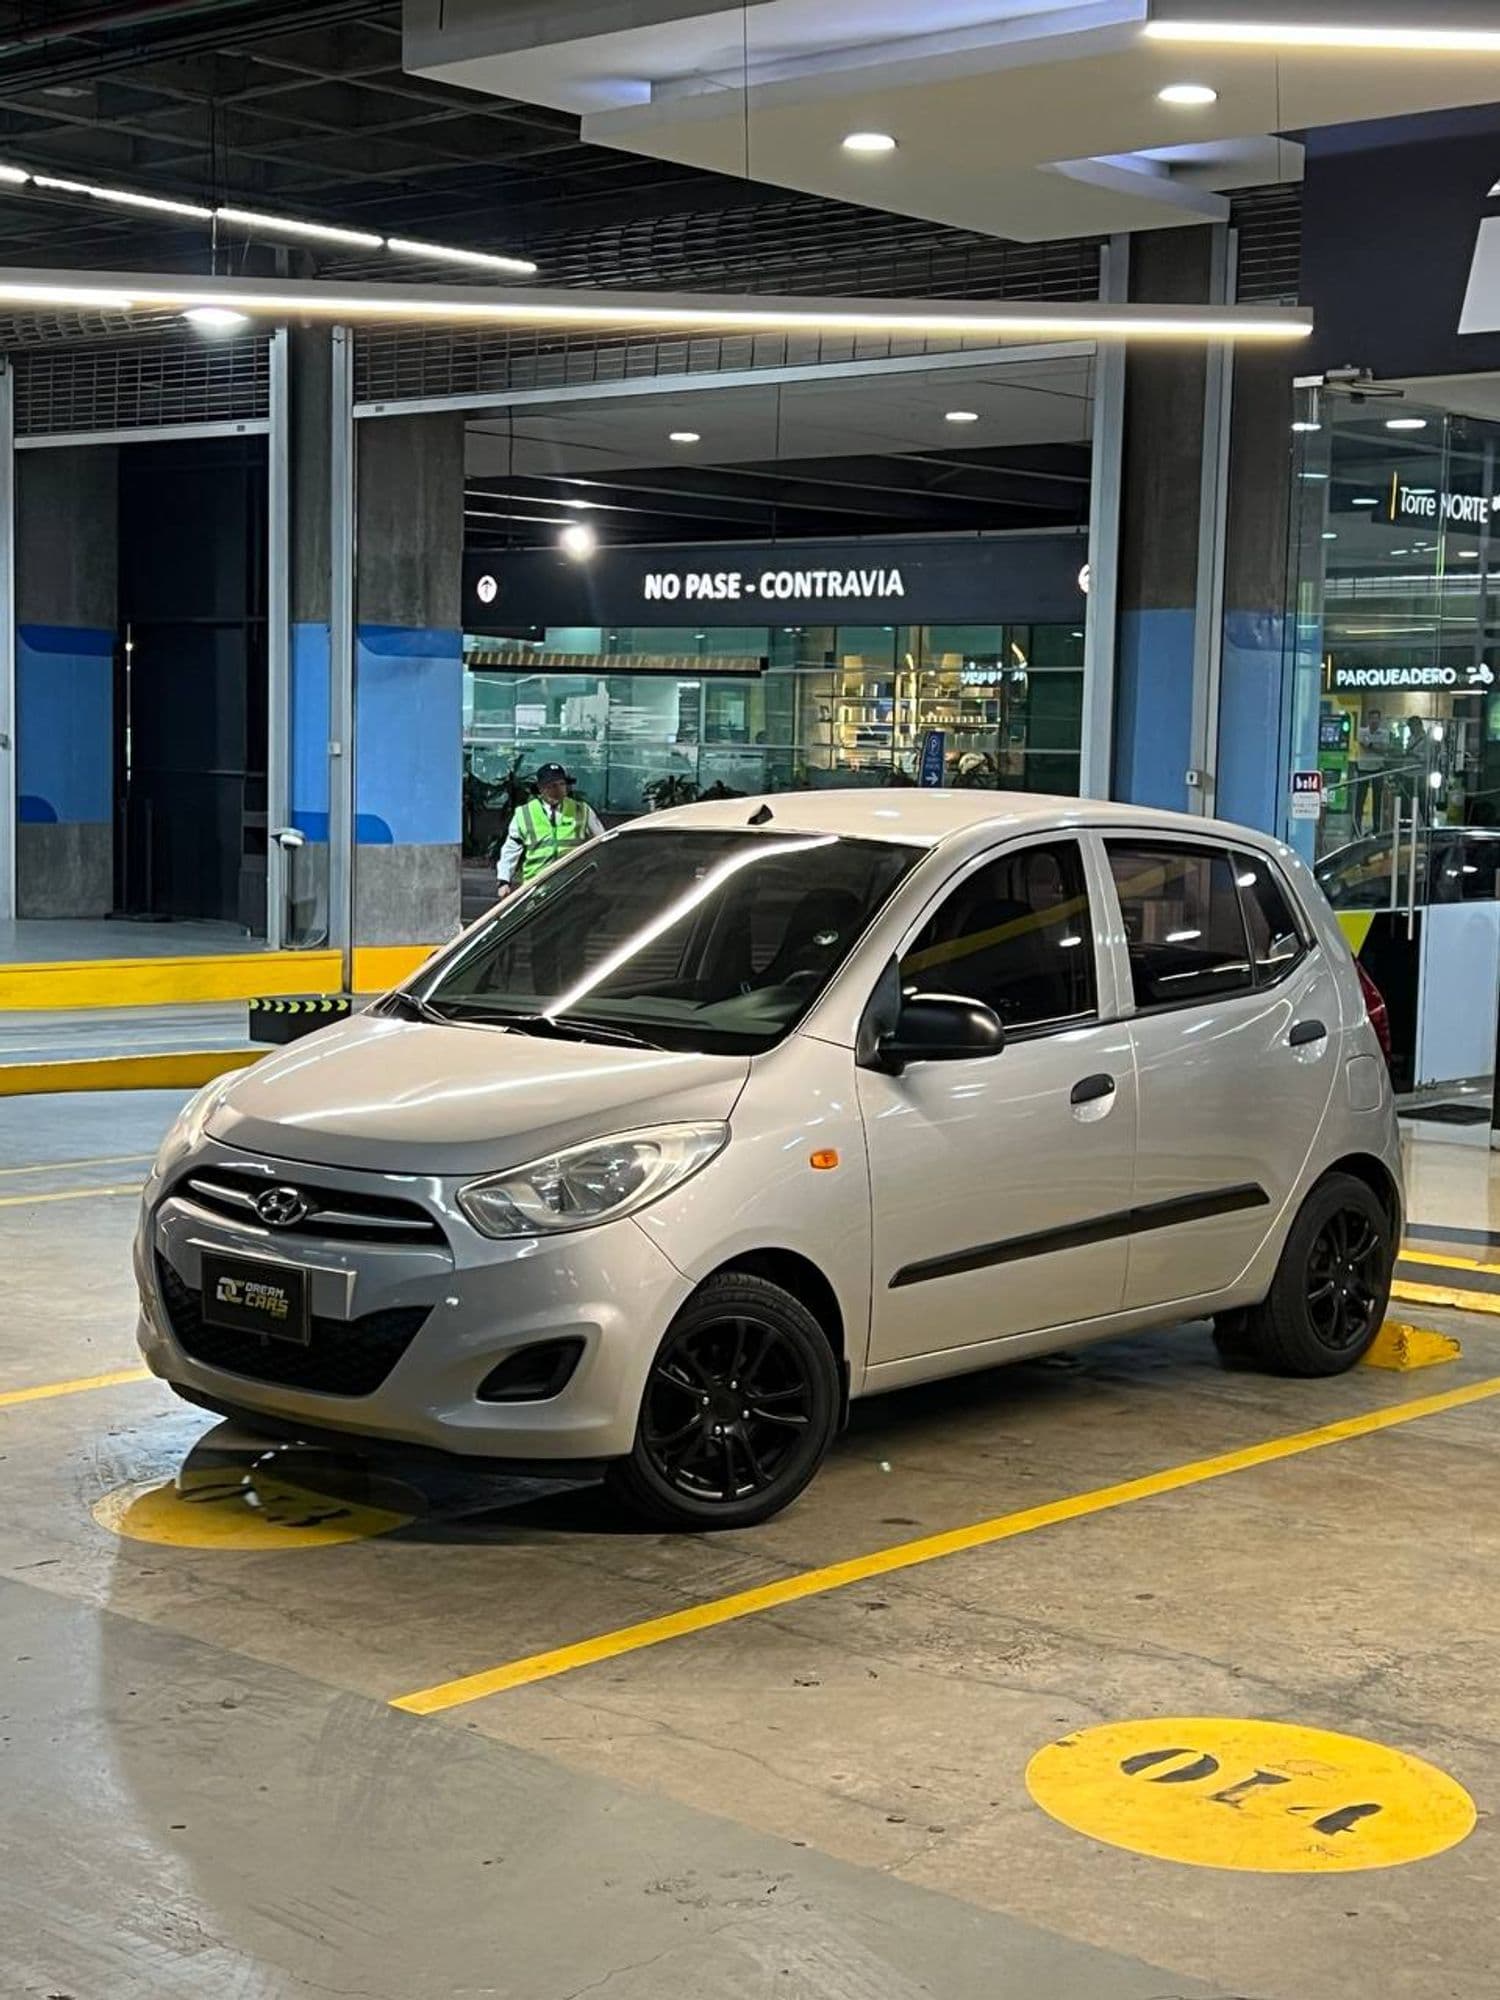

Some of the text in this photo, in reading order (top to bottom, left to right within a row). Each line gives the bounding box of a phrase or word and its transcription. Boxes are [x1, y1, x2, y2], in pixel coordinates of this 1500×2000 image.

[1400, 486, 1489, 523] Torre NORTE
[644, 573, 681, 599] NO
[685, 573, 742, 599] PASE
[759, 569, 905, 599] CONTRAVIA
[1337, 667, 1457, 687] PARQUEADERO
[245, 1282, 285, 1299] DREAM
[245, 1293, 289, 1312] CARS
